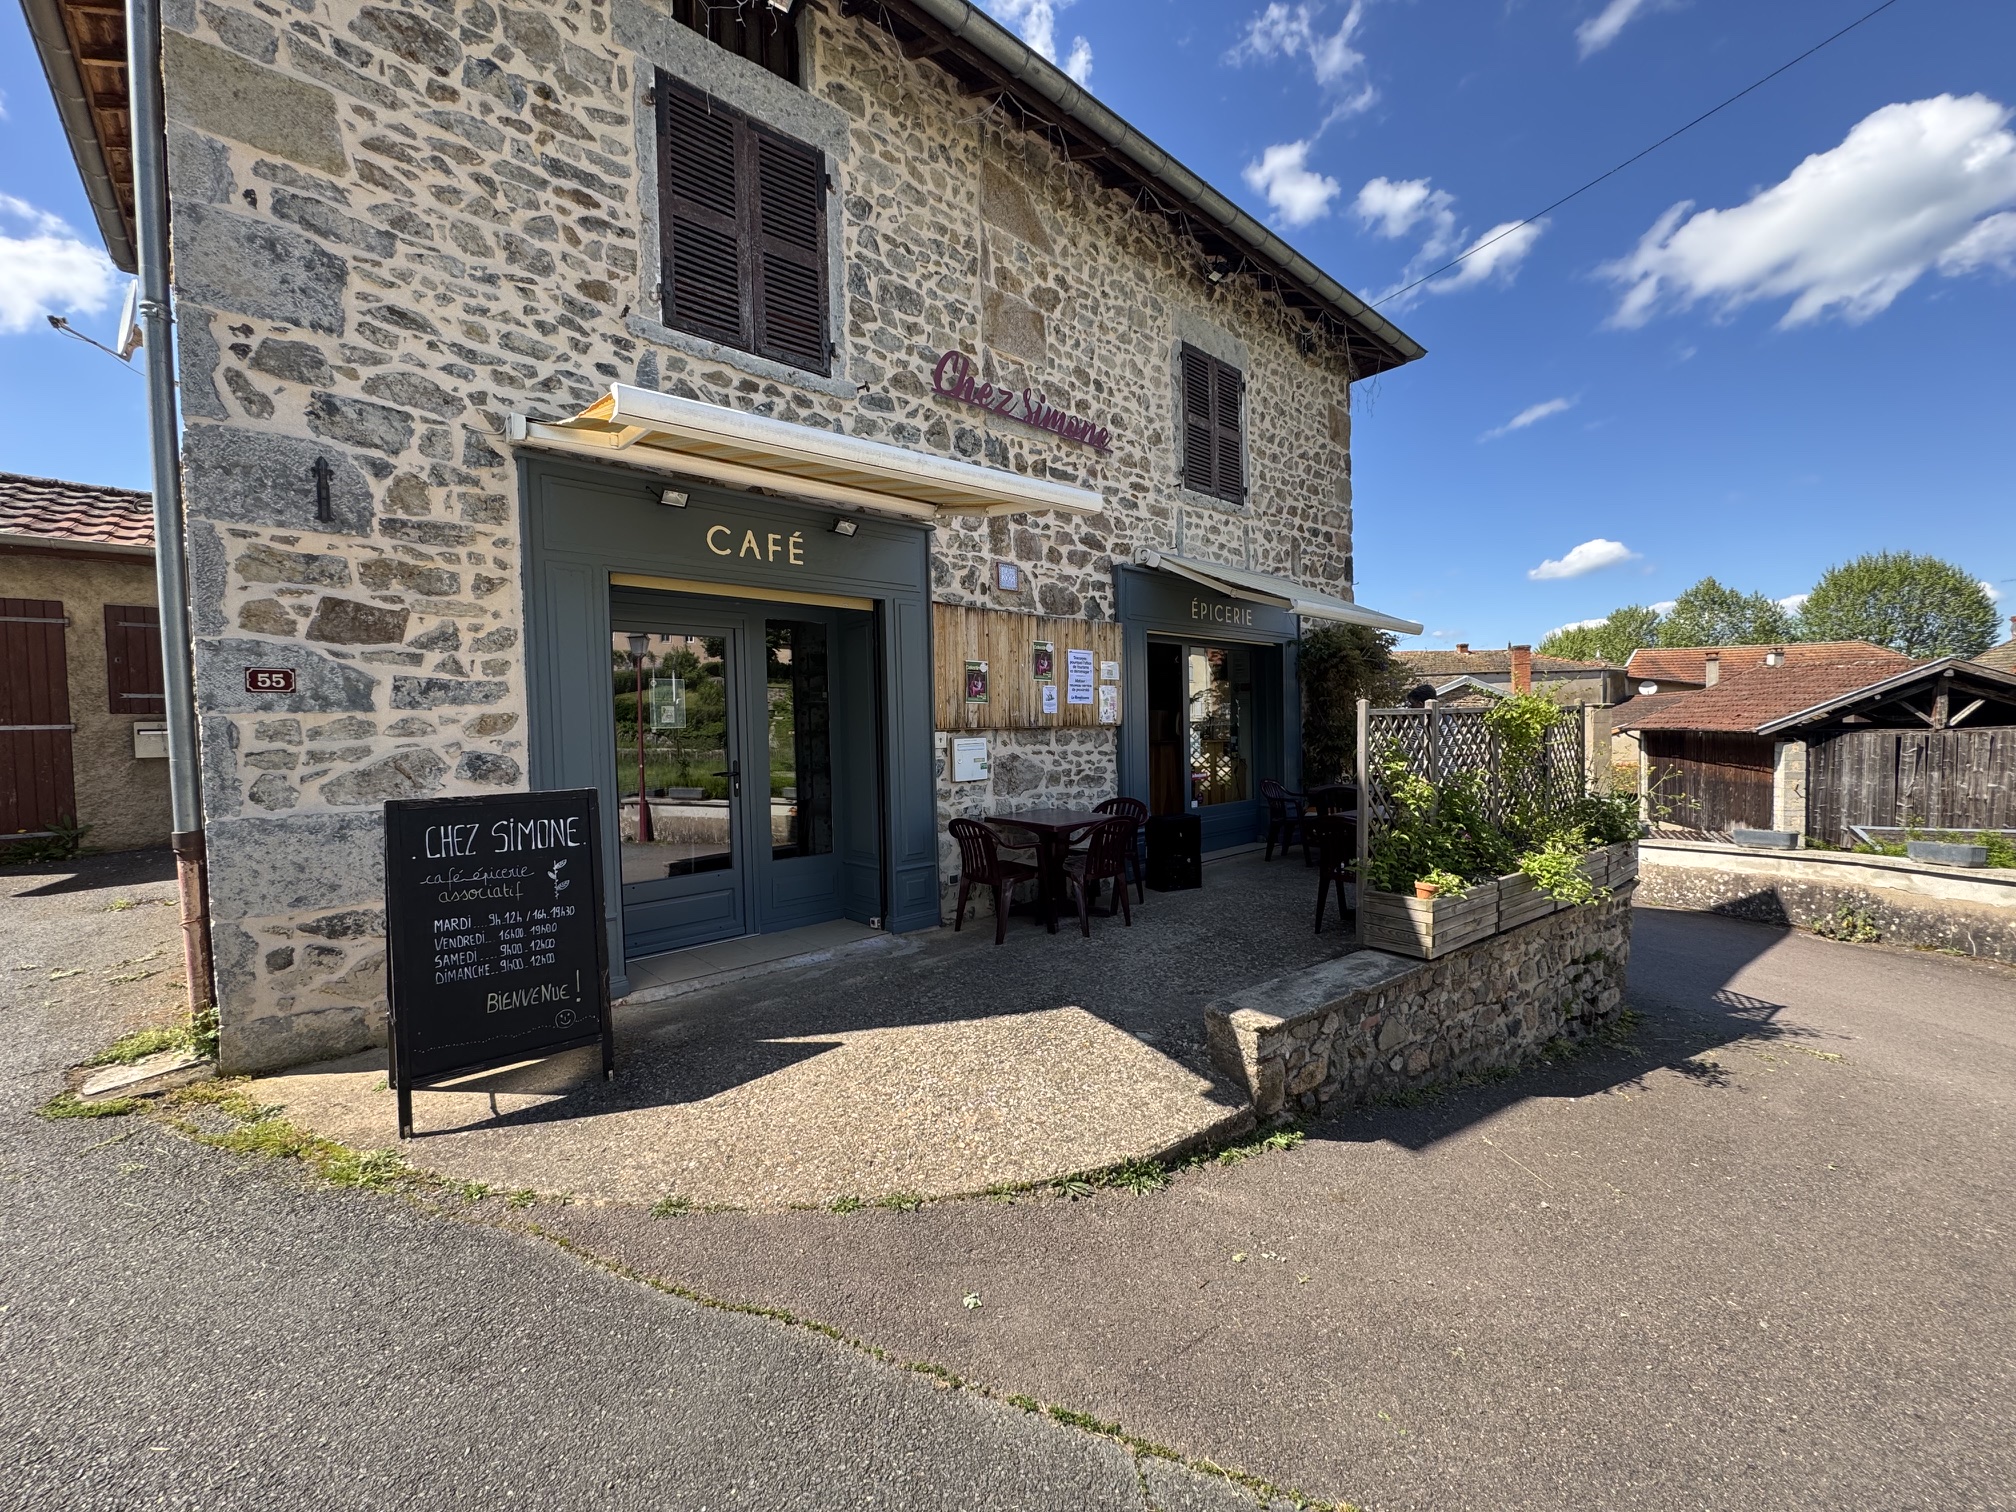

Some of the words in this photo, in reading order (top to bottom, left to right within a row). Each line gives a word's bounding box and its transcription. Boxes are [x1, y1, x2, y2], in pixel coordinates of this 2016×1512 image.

[931, 350, 1018, 414] Chez
[1022, 388, 1113, 453] Simone
[706, 525, 804, 565] CAFÉ
[1191, 597, 1252, 626] ÉPICERIE
[257, 673, 286, 687] 55
[426, 823, 479, 858] CHEZ
[491, 817, 580, 853] SIMONE
[420, 867, 465, 891] café
[471, 866, 535, 885] épicerie
[439, 881, 524, 902] associatif
[487, 983, 571, 1013] BIENVENUE
